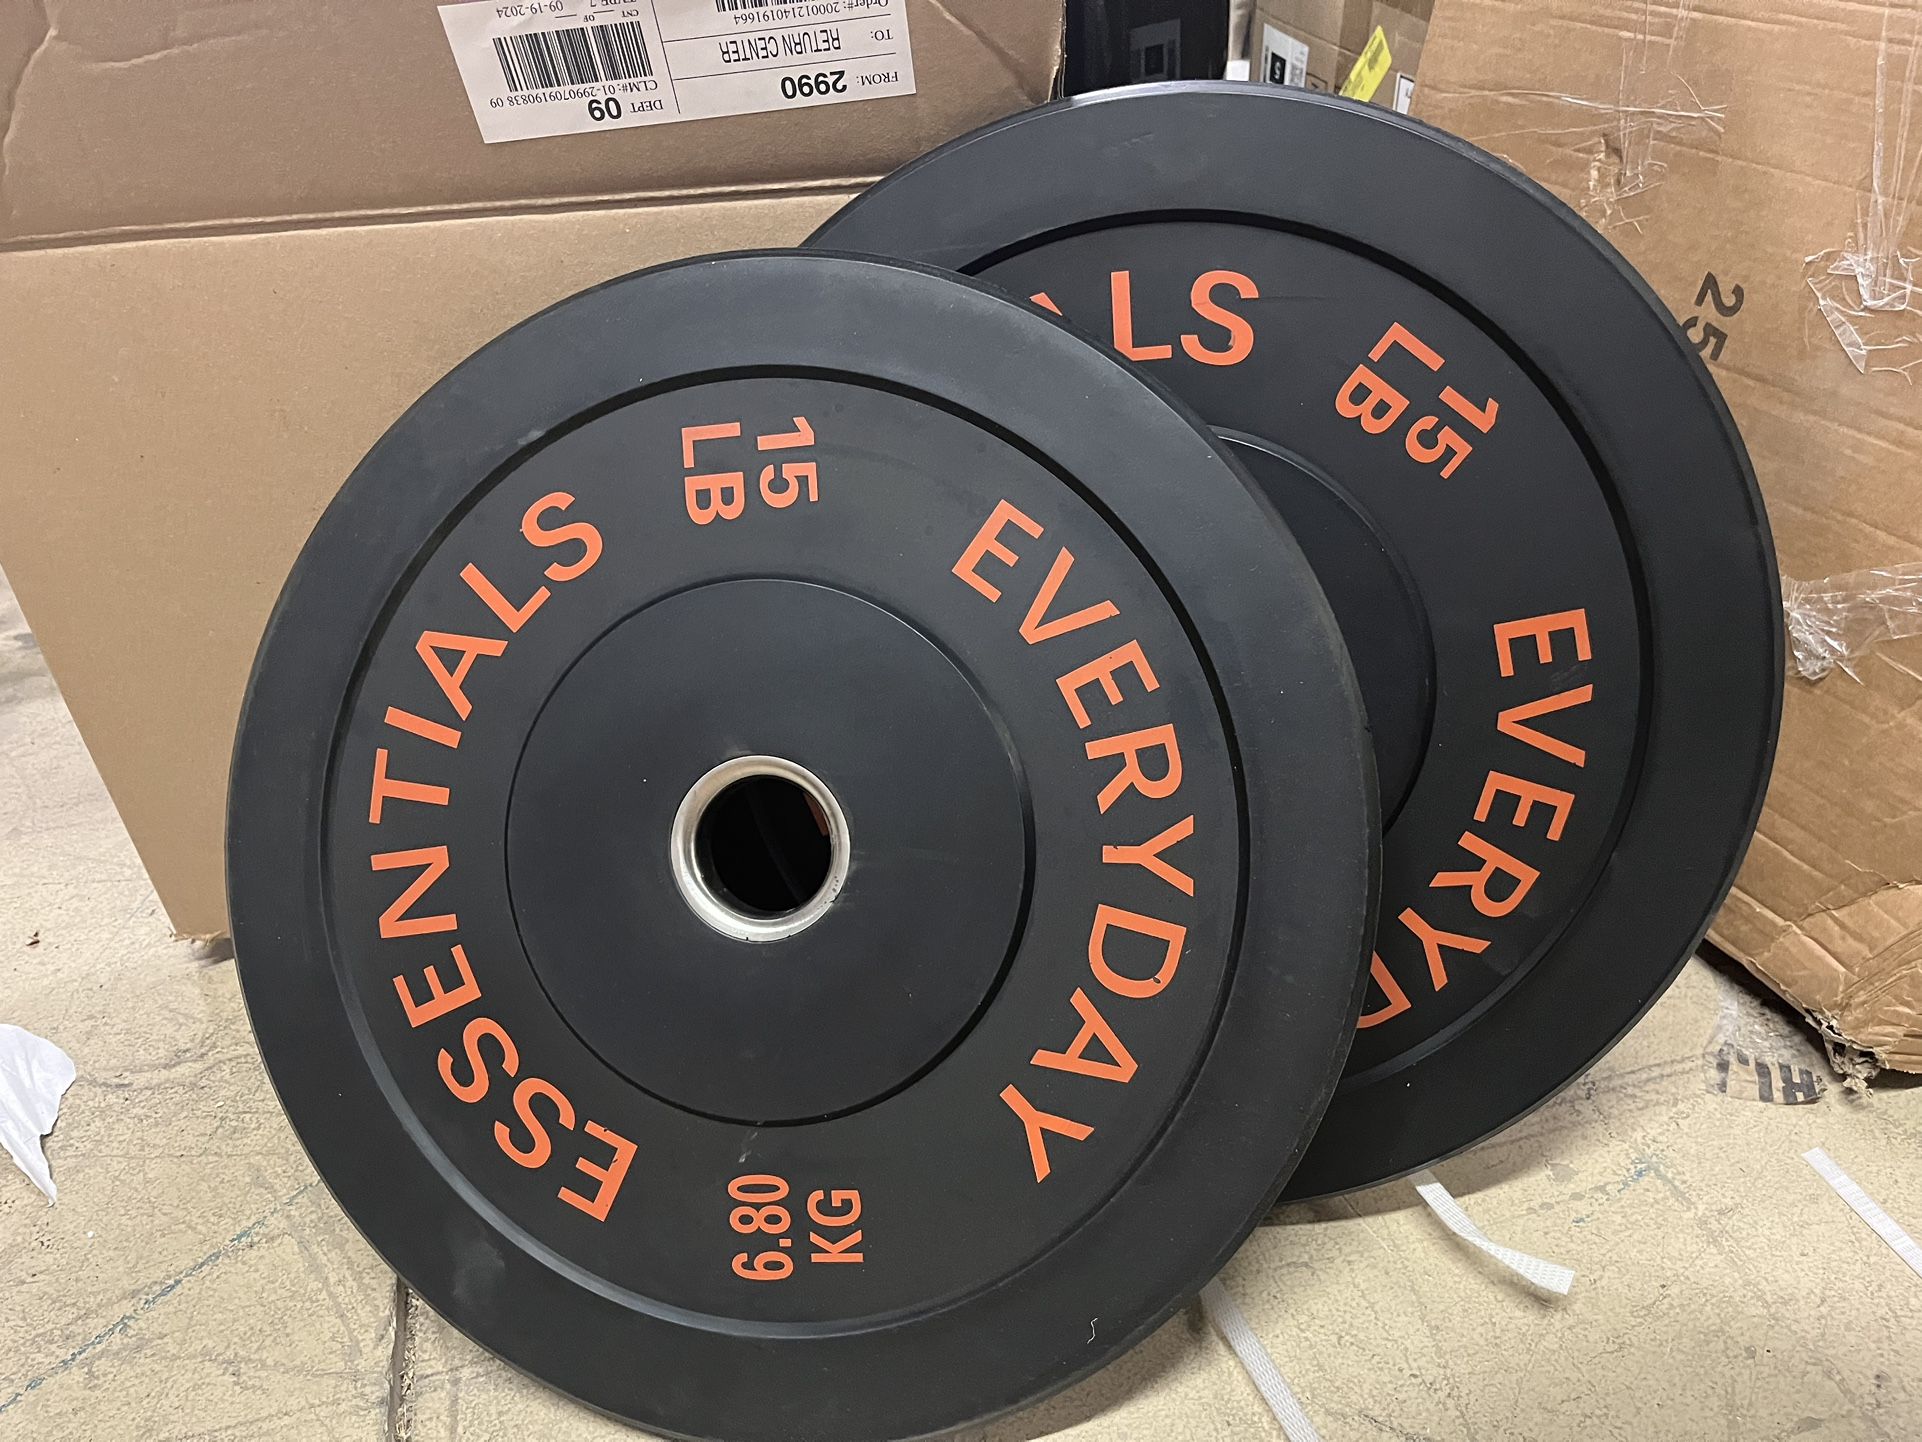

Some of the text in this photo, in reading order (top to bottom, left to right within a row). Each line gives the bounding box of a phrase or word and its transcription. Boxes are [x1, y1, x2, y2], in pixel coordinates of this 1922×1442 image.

[496, 1, 564, 18] 09-19-2024
[583, 9, 639, 22] CNT OF
[734, 1, 841, 25] 200012140191664
[870, 29, 894, 41] TO:
[718, 28, 842, 64] RETURN CENTER
[489, 79, 658, 109] CLM#: 01-2990709190838 09
[587, 97, 664, 121] DEPT 09
[780, 70, 899, 99] FROM: 2990
[1681, 271, 1744, 361] 25
[1335, 321, 1446, 434] LB
[681, 421, 746, 515] LB
[757, 416, 819, 509] 15
[1405, 385, 1499, 479] 15
[368, 492, 638, 1222] ESSENTIALS
[951, 499, 1194, 1183] EVERYDAY
[727, 1174, 794, 1281] 6.80
[806, 1190, 864, 1262] KG
